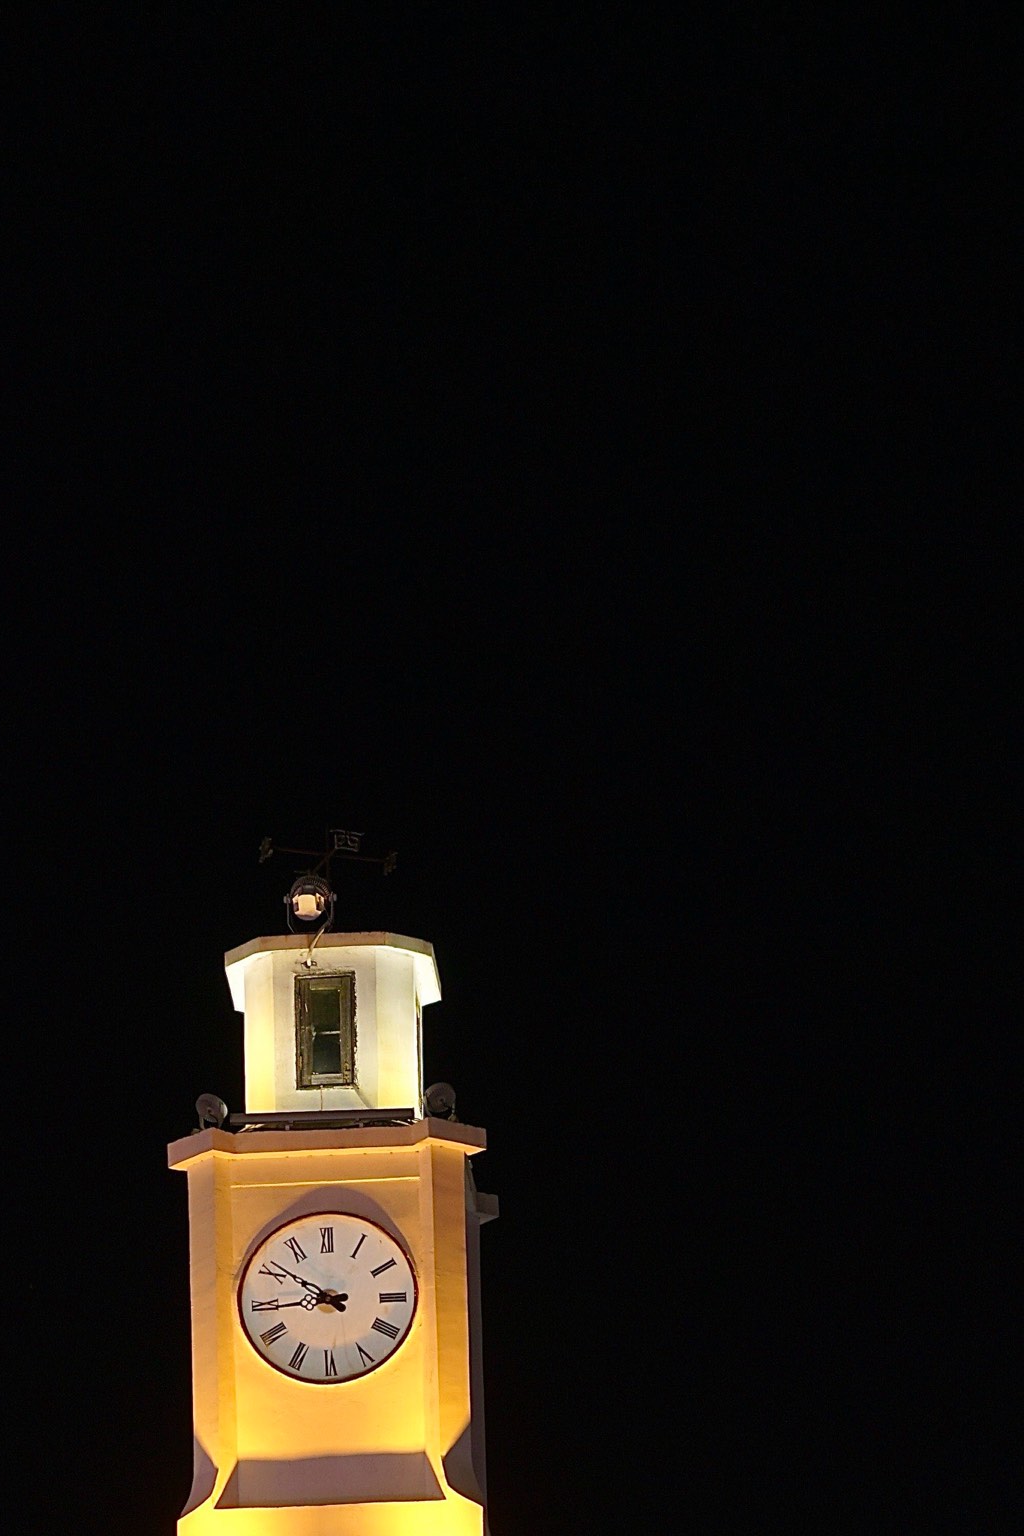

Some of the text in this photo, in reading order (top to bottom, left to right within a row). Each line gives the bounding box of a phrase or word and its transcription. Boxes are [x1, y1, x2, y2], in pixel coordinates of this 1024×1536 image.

[283, 1237, 308, 1264] XI
[319, 1227, 334, 1253] XII
[370, 1257, 397, 1278] II
[379, 1292, 407, 1303] III
[260, 1321, 288, 1347] VIII
[288, 1342, 309, 1371] VII
[324, 1349, 338, 1376] VI
[355, 1342, 376, 1367] V
